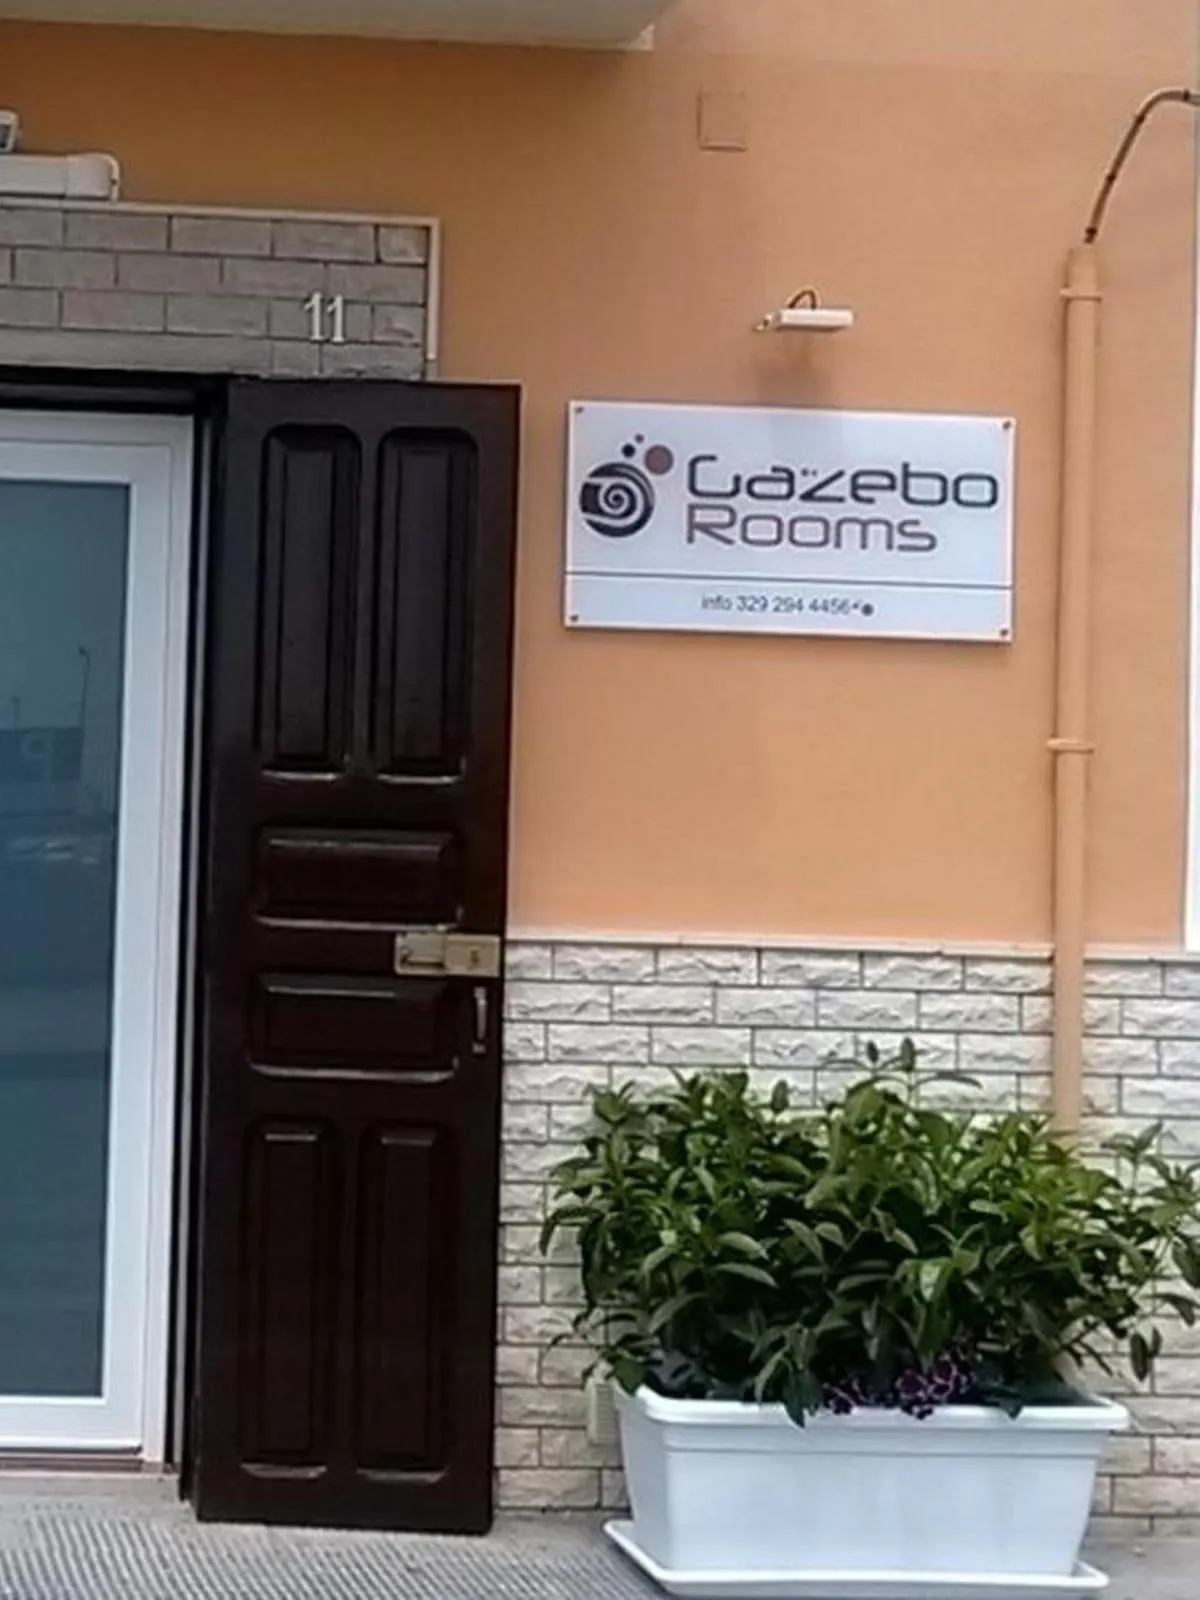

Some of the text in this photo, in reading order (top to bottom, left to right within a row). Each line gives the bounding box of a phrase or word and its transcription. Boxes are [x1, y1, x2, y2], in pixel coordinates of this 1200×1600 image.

[303, 291, 345, 342] 11
[687, 455, 999, 508] Gazebo
[686, 504, 937, 552] Rooms
[736, 595, 768, 613] 329
[771, 596, 804, 613] 294
